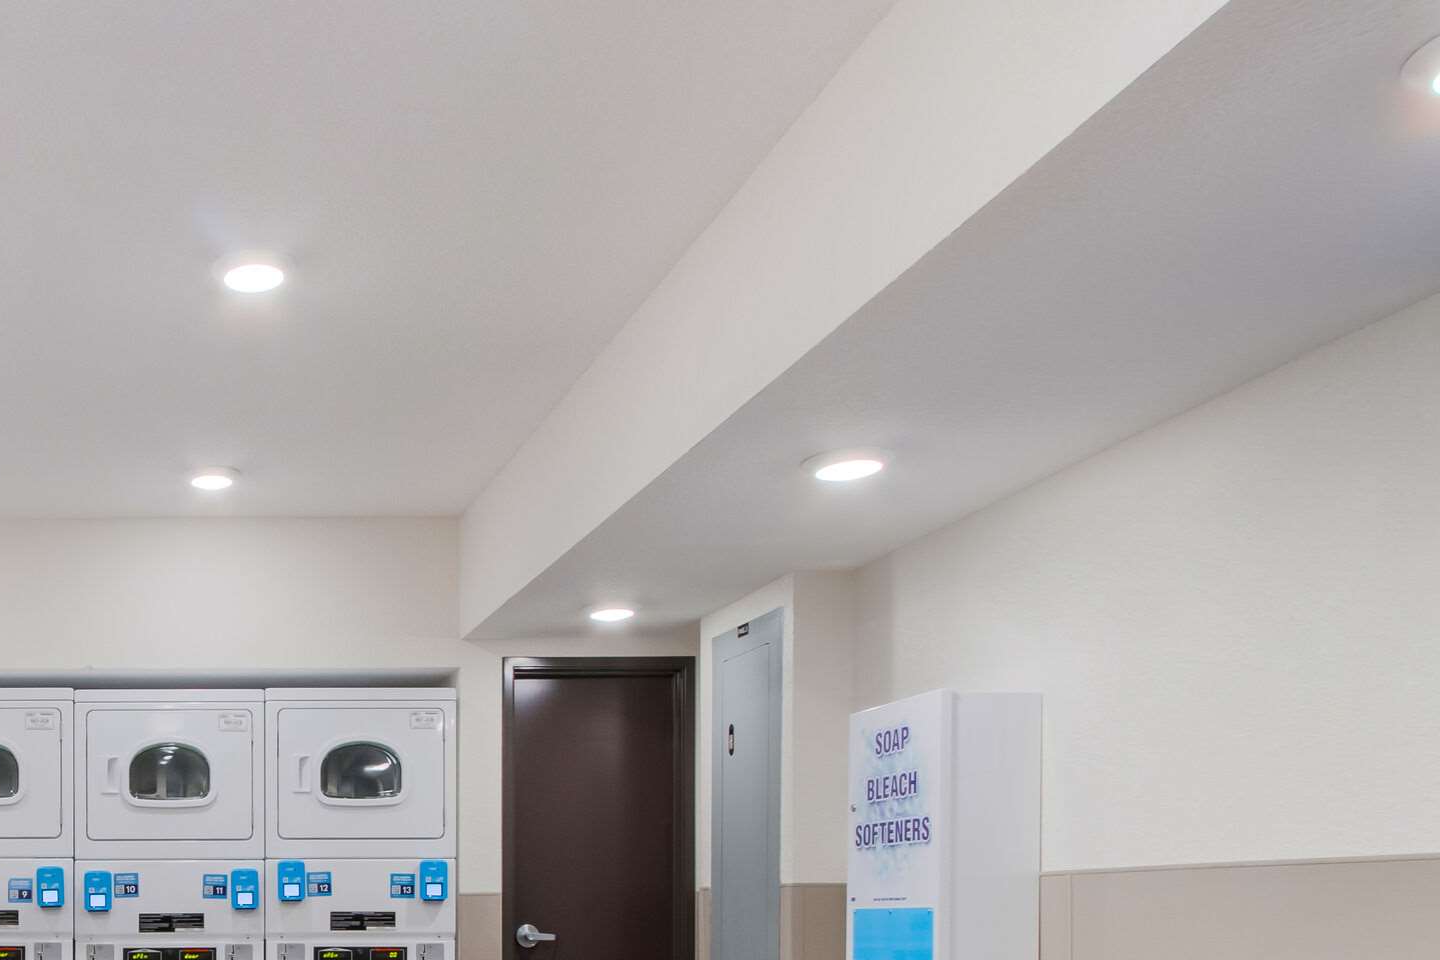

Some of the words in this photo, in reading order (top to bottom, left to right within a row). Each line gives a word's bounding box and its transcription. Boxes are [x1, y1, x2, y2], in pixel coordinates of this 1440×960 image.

[875, 726, 909, 755] SOAP
[867, 771, 917, 801] BLEACH
[855, 816, 930, 847] SOFTENERS
[319, 884, 329, 892] 12
[402, 886, 412, 894] 13
